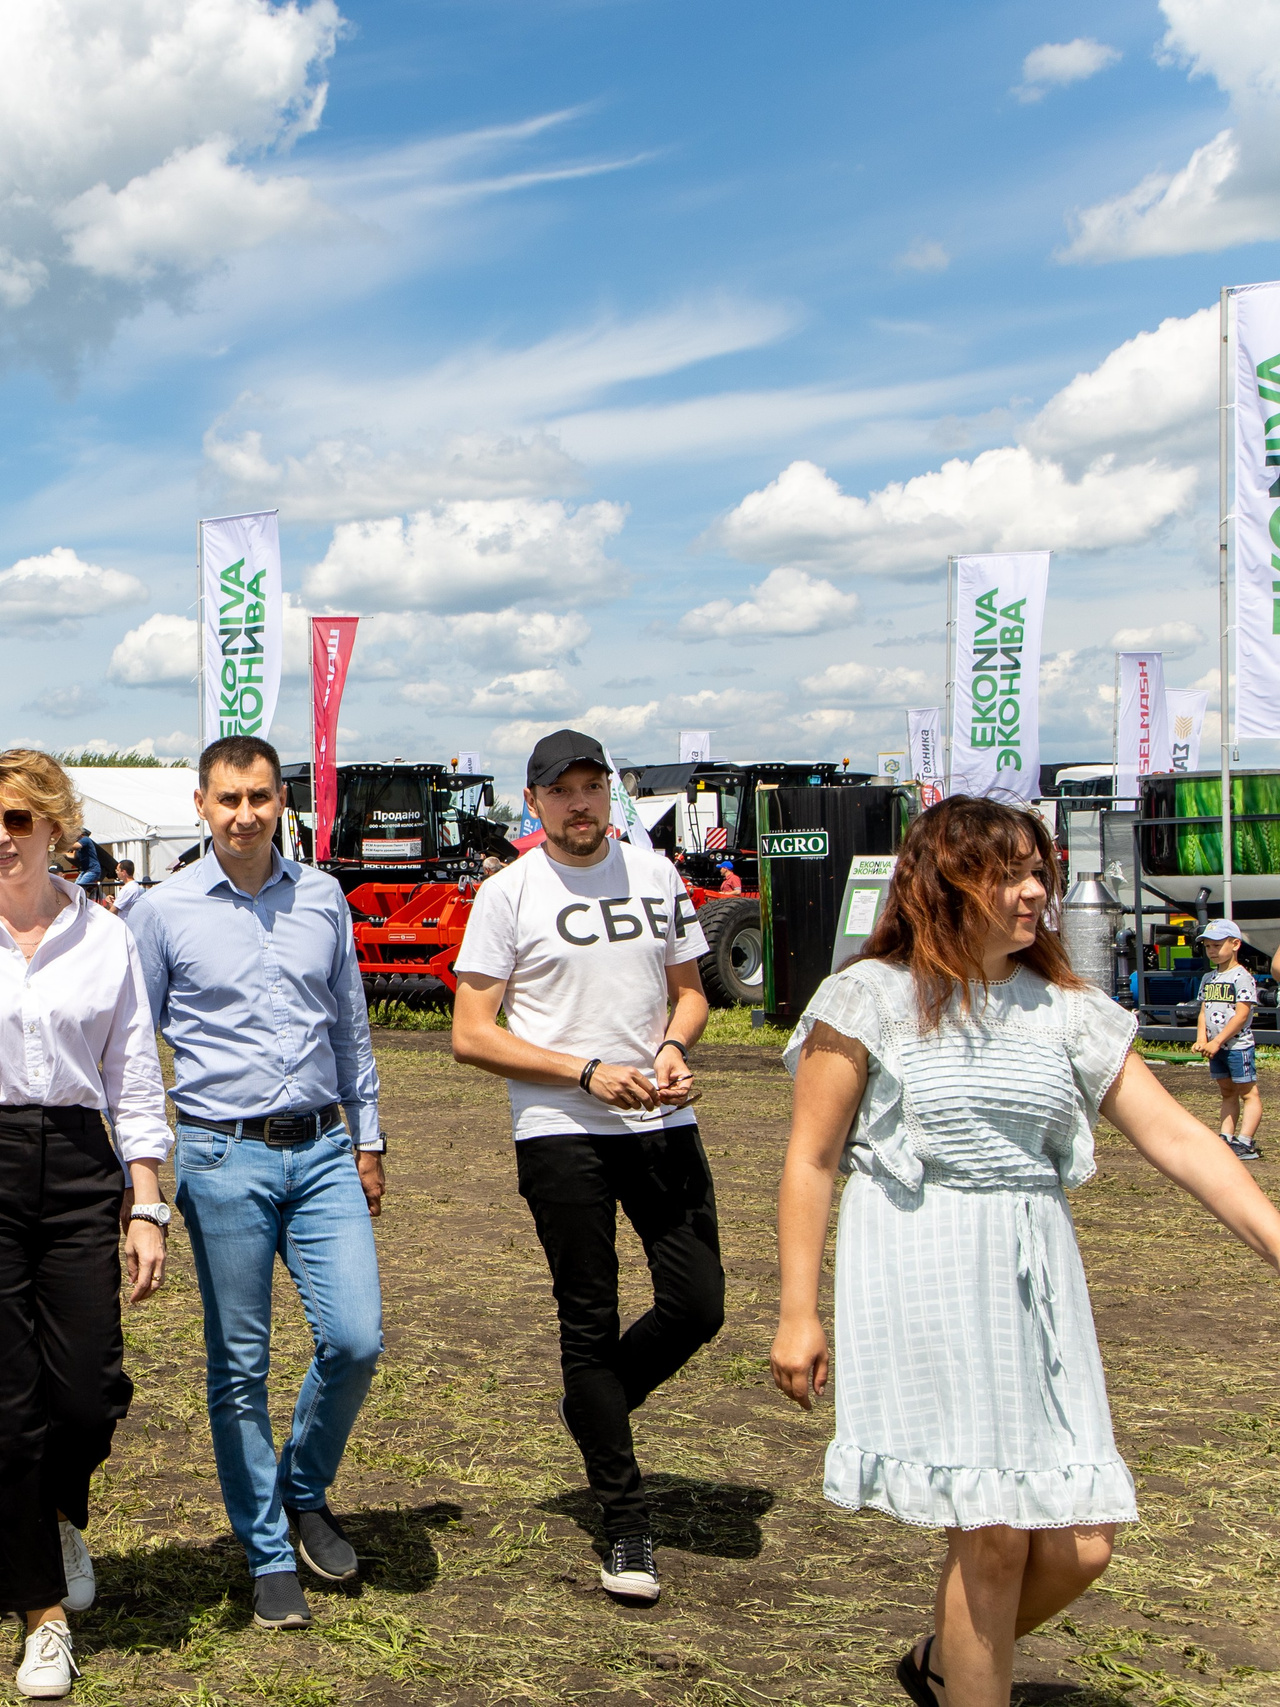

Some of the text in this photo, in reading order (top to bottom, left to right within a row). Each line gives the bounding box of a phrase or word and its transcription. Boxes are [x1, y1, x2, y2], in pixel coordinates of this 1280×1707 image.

[219, 557, 245, 737] EKONIVA
[238, 568, 266, 736] КОНИВА
[971, 587, 999, 748] EKONIVA
[996, 597, 1027, 772] ЭКОНИВА
[920, 729, 932, 780] Техника
[1138, 661, 1150, 774] SELMASH
[373, 811, 420, 822] Продано
[762, 836, 824, 854] NAGRO
